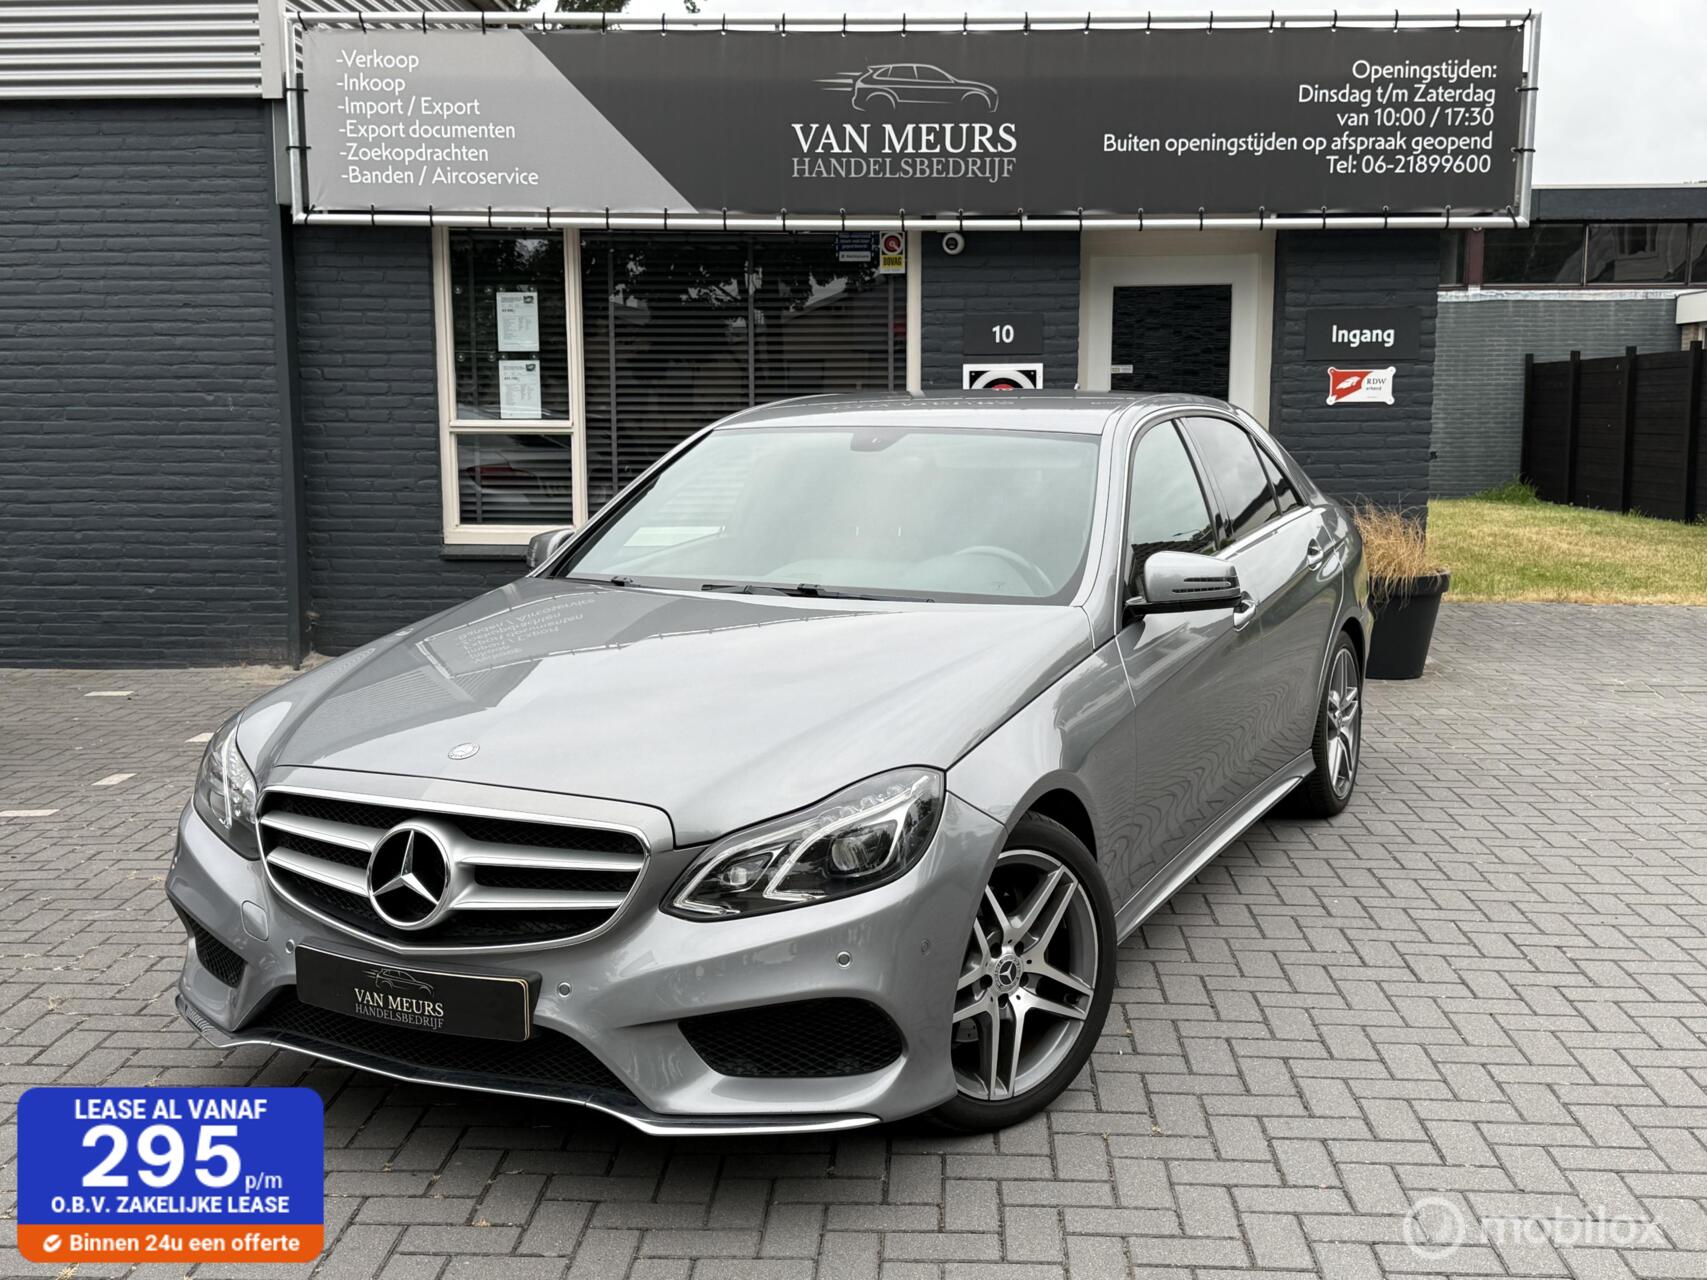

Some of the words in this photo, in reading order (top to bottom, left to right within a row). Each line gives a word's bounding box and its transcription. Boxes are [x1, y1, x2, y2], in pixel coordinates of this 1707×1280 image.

[336, 50, 419, 72] -Verkoop
[1352, 59, 1497, 82] Openingstijden:
[337, 73, 405, 95] -Inkoop
[1299, 85, 1371, 106] Dinsdag
[1376, 84, 1408, 104] t/m
[1413, 84, 1496, 106] Zaterdag
[337, 96, 404, 118] -Import
[408, 96, 416, 116] /
[421, 97, 480, 119] Export
[1337, 111, 1369, 126] van
[1374, 108, 1426, 127] 10:00
[1430, 107, 1440, 127] /
[1445, 107, 1494, 127] 17:30
[339, 120, 405, 142] -Export
[409, 120, 515, 138] documenten
[792, 123, 871, 153] VAN
[881, 123, 1017, 153] MEURS
[340, 143, 489, 165] -Zoekopdrachten
[1103, 133, 1160, 152] Buiten
[1165, 132, 1297, 156] openingstijden
[1302, 136, 1326, 155] op
[1331, 131, 1406, 156] afspraak
[1411, 131, 1493, 155] geopend
[341, 166, 414, 184] -Banden
[418, 166, 427, 186] /
[432, 167, 539, 185] Aircoservice
[792, 157, 1016, 183] HANDELSBEDRIJF
[1326, 156, 1356, 175] Tel:
[1361, 155, 1491, 174] 06-21899600
[992, 325, 1014, 343] 10
[1332, 325, 1394, 347] Ingang
[354, 988, 384, 1007] VAN
[388, 996, 444, 1016] MEURS
[355, 1003, 444, 1030] HANDELSBEDRIJF
